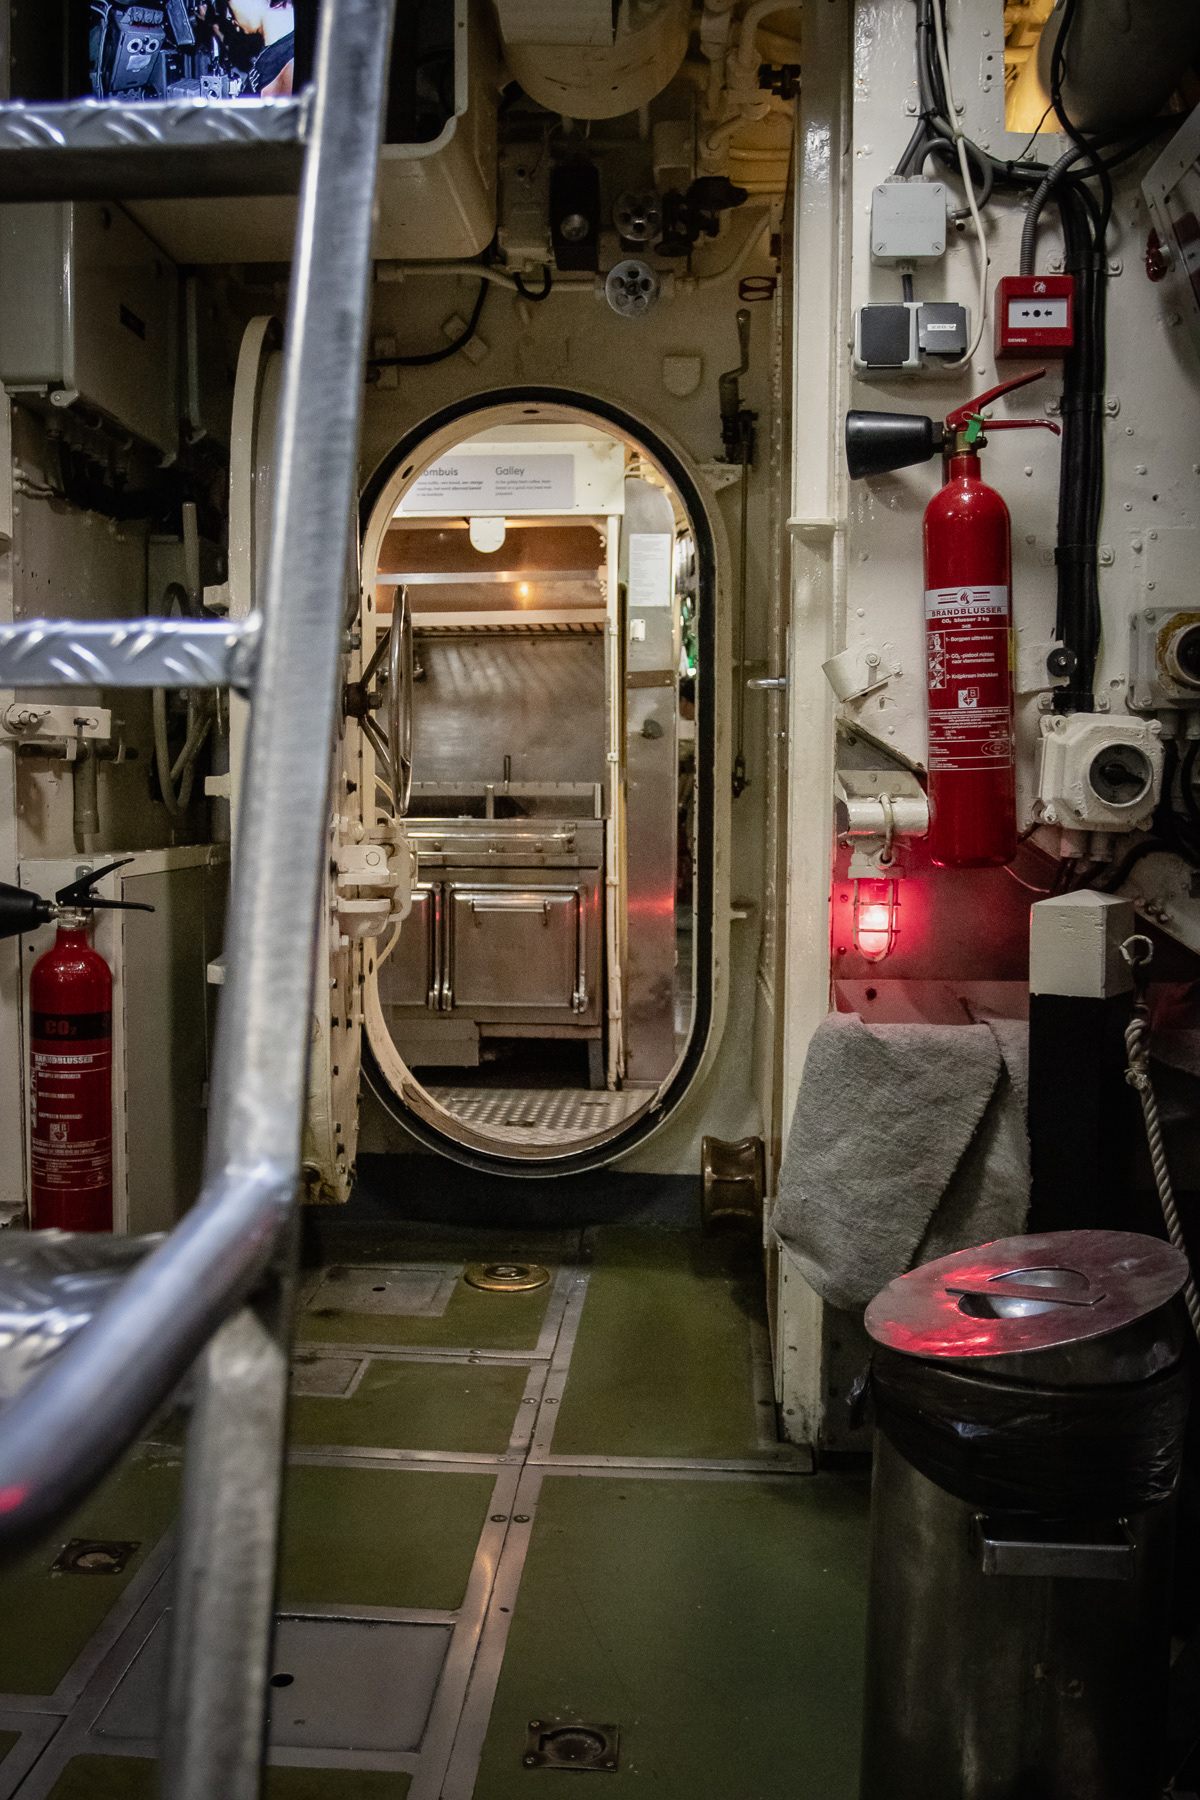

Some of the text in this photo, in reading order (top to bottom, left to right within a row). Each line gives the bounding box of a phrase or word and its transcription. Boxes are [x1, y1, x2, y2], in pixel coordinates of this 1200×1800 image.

[421, 467, 459, 476] ombuis
[495, 466, 525, 477] Galley
[931, 607, 1002, 617] BRANDBLUSSER
[45, 1020, 78, 1035] CO2
[34, 1054, 93, 1064] BRANDBLUSSER
